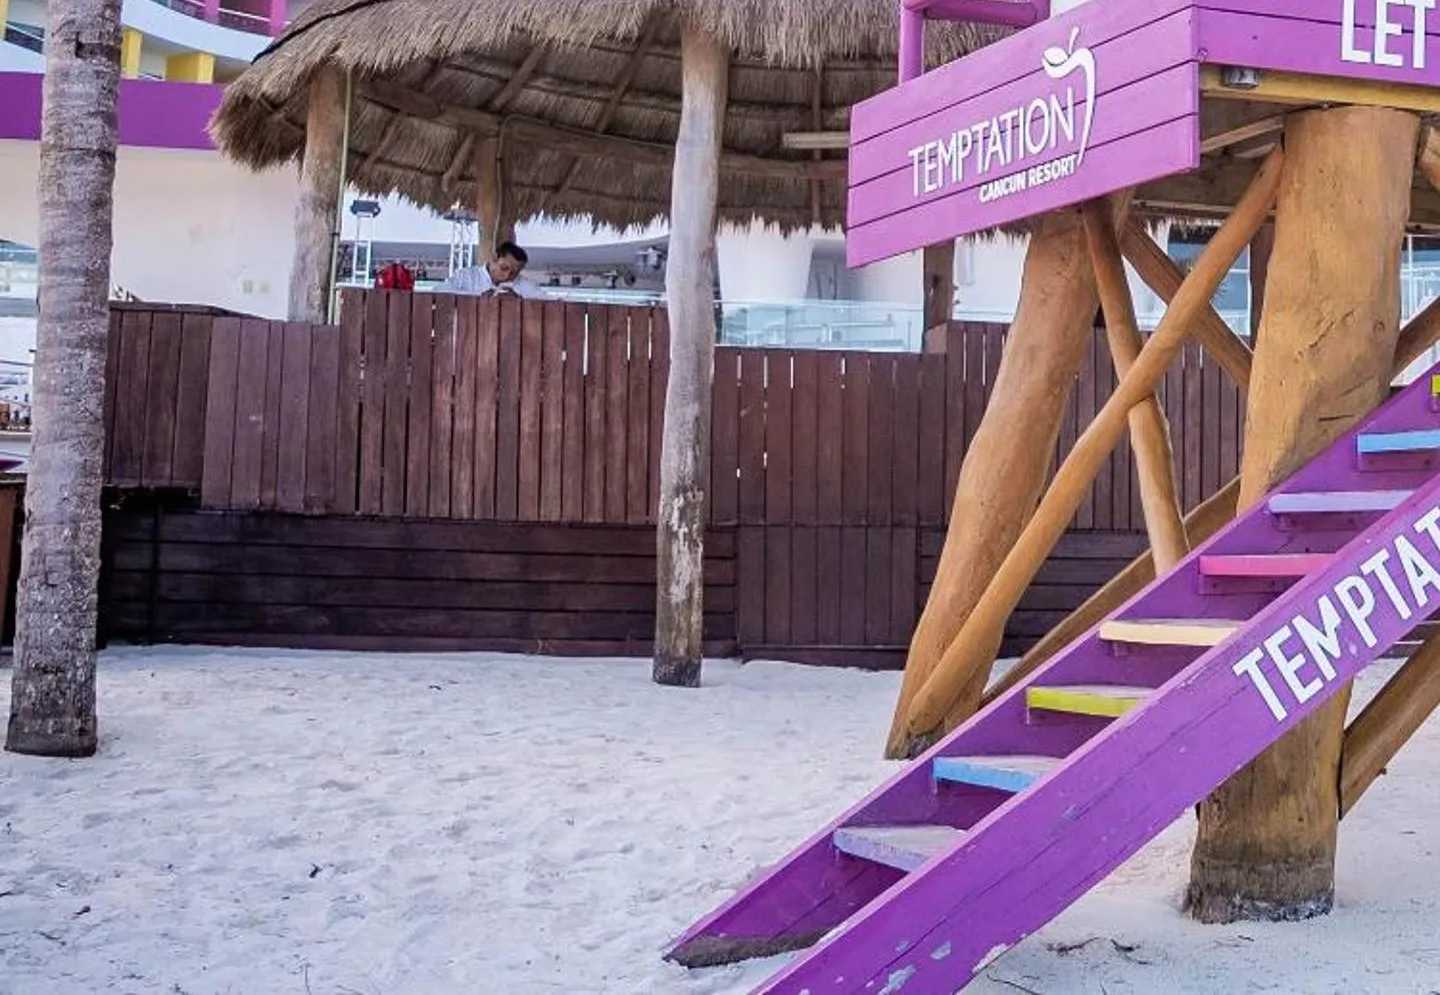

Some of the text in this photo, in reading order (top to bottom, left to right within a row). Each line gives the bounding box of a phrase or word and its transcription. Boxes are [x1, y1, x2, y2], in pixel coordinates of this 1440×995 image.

[907, 86, 1074, 197] TEMPTATION
[978, 154, 1078, 203] CANCUN RESORT
